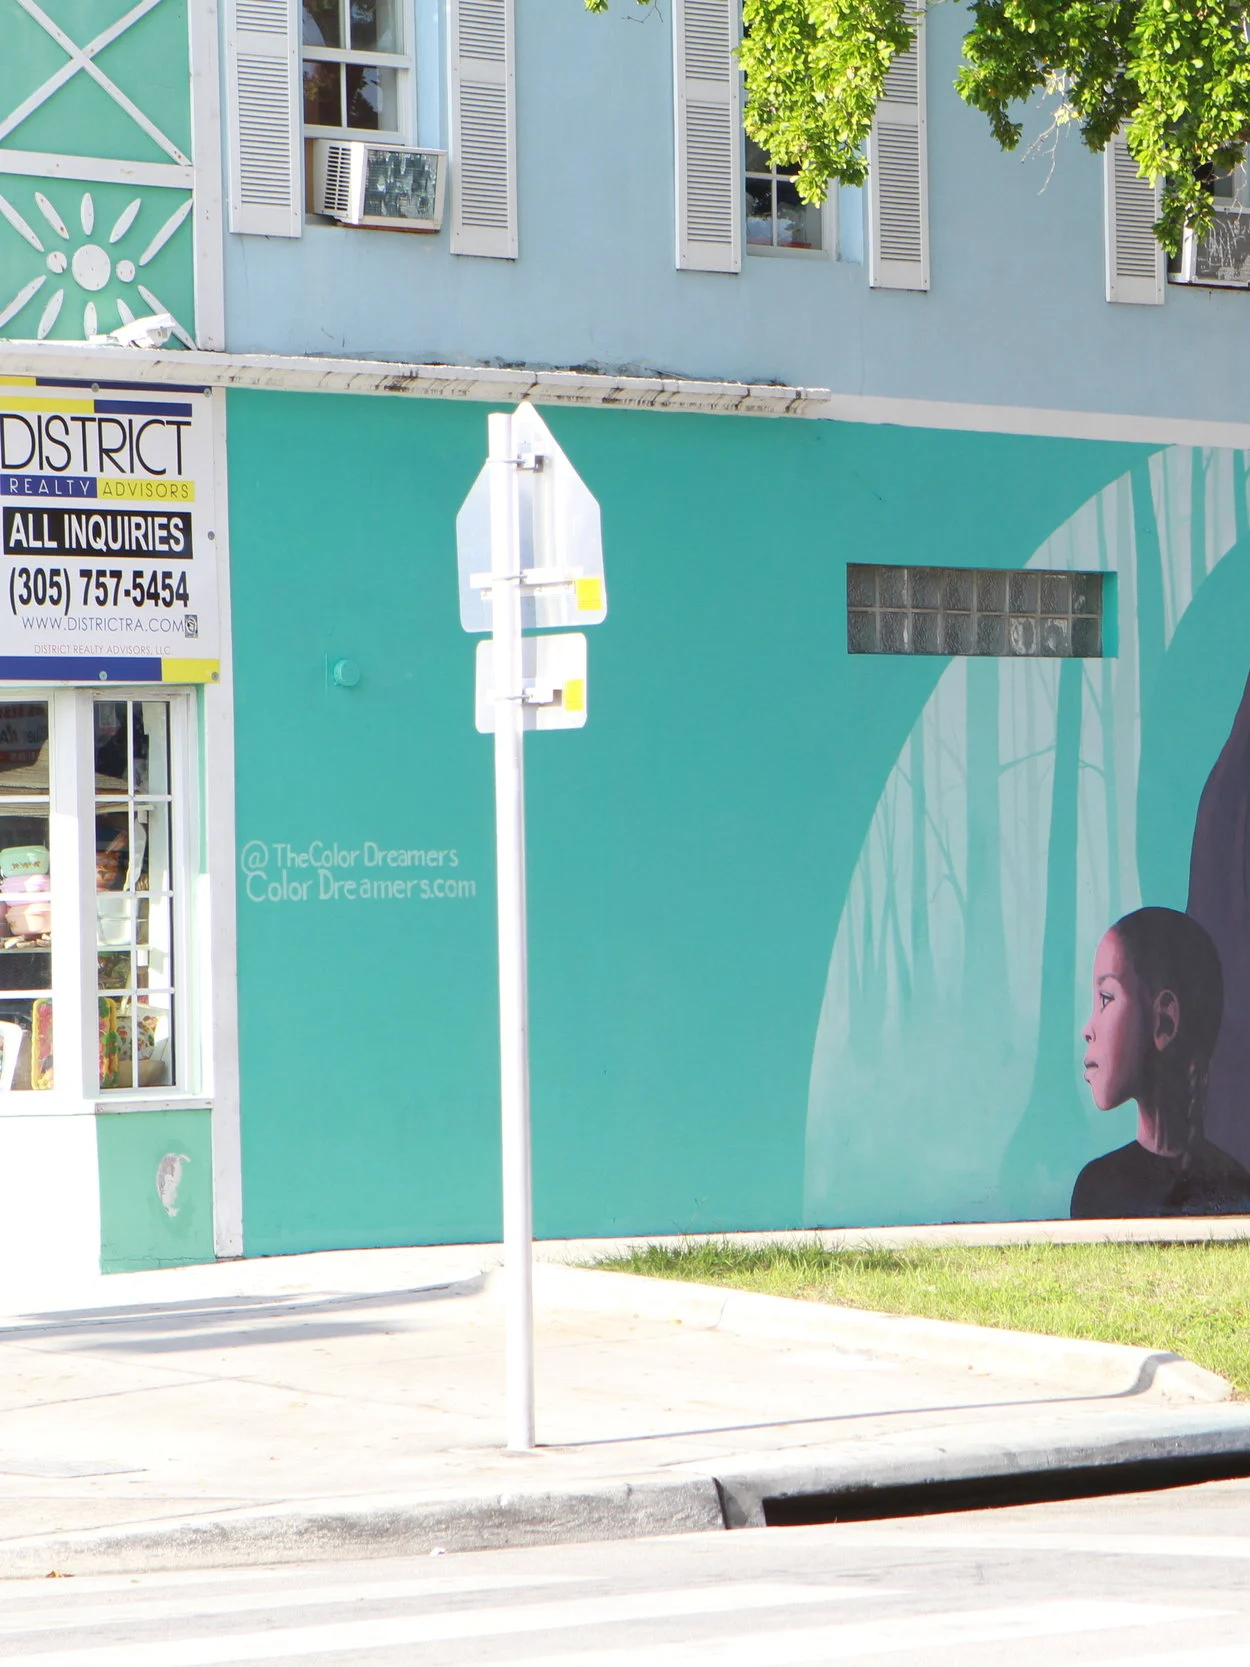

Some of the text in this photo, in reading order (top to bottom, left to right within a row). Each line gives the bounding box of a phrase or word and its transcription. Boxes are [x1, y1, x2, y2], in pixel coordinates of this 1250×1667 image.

[0, 414, 192, 476] DISTRICT
[9, 478, 190, 500] REALTY ADVISORS
[9, 512, 185, 552] ALL INQUIRIES
[9, 567, 190, 615] (305) 757-5454
[22, 616, 184, 634] WWW.DISTRICTRA.COM
[34, 644, 71, 655] DISTRICT
[73, 645, 104, 655] REALTY
[106, 646, 154, 656] ADVISORS,
[363, 841, 459, 868] Dreamers
